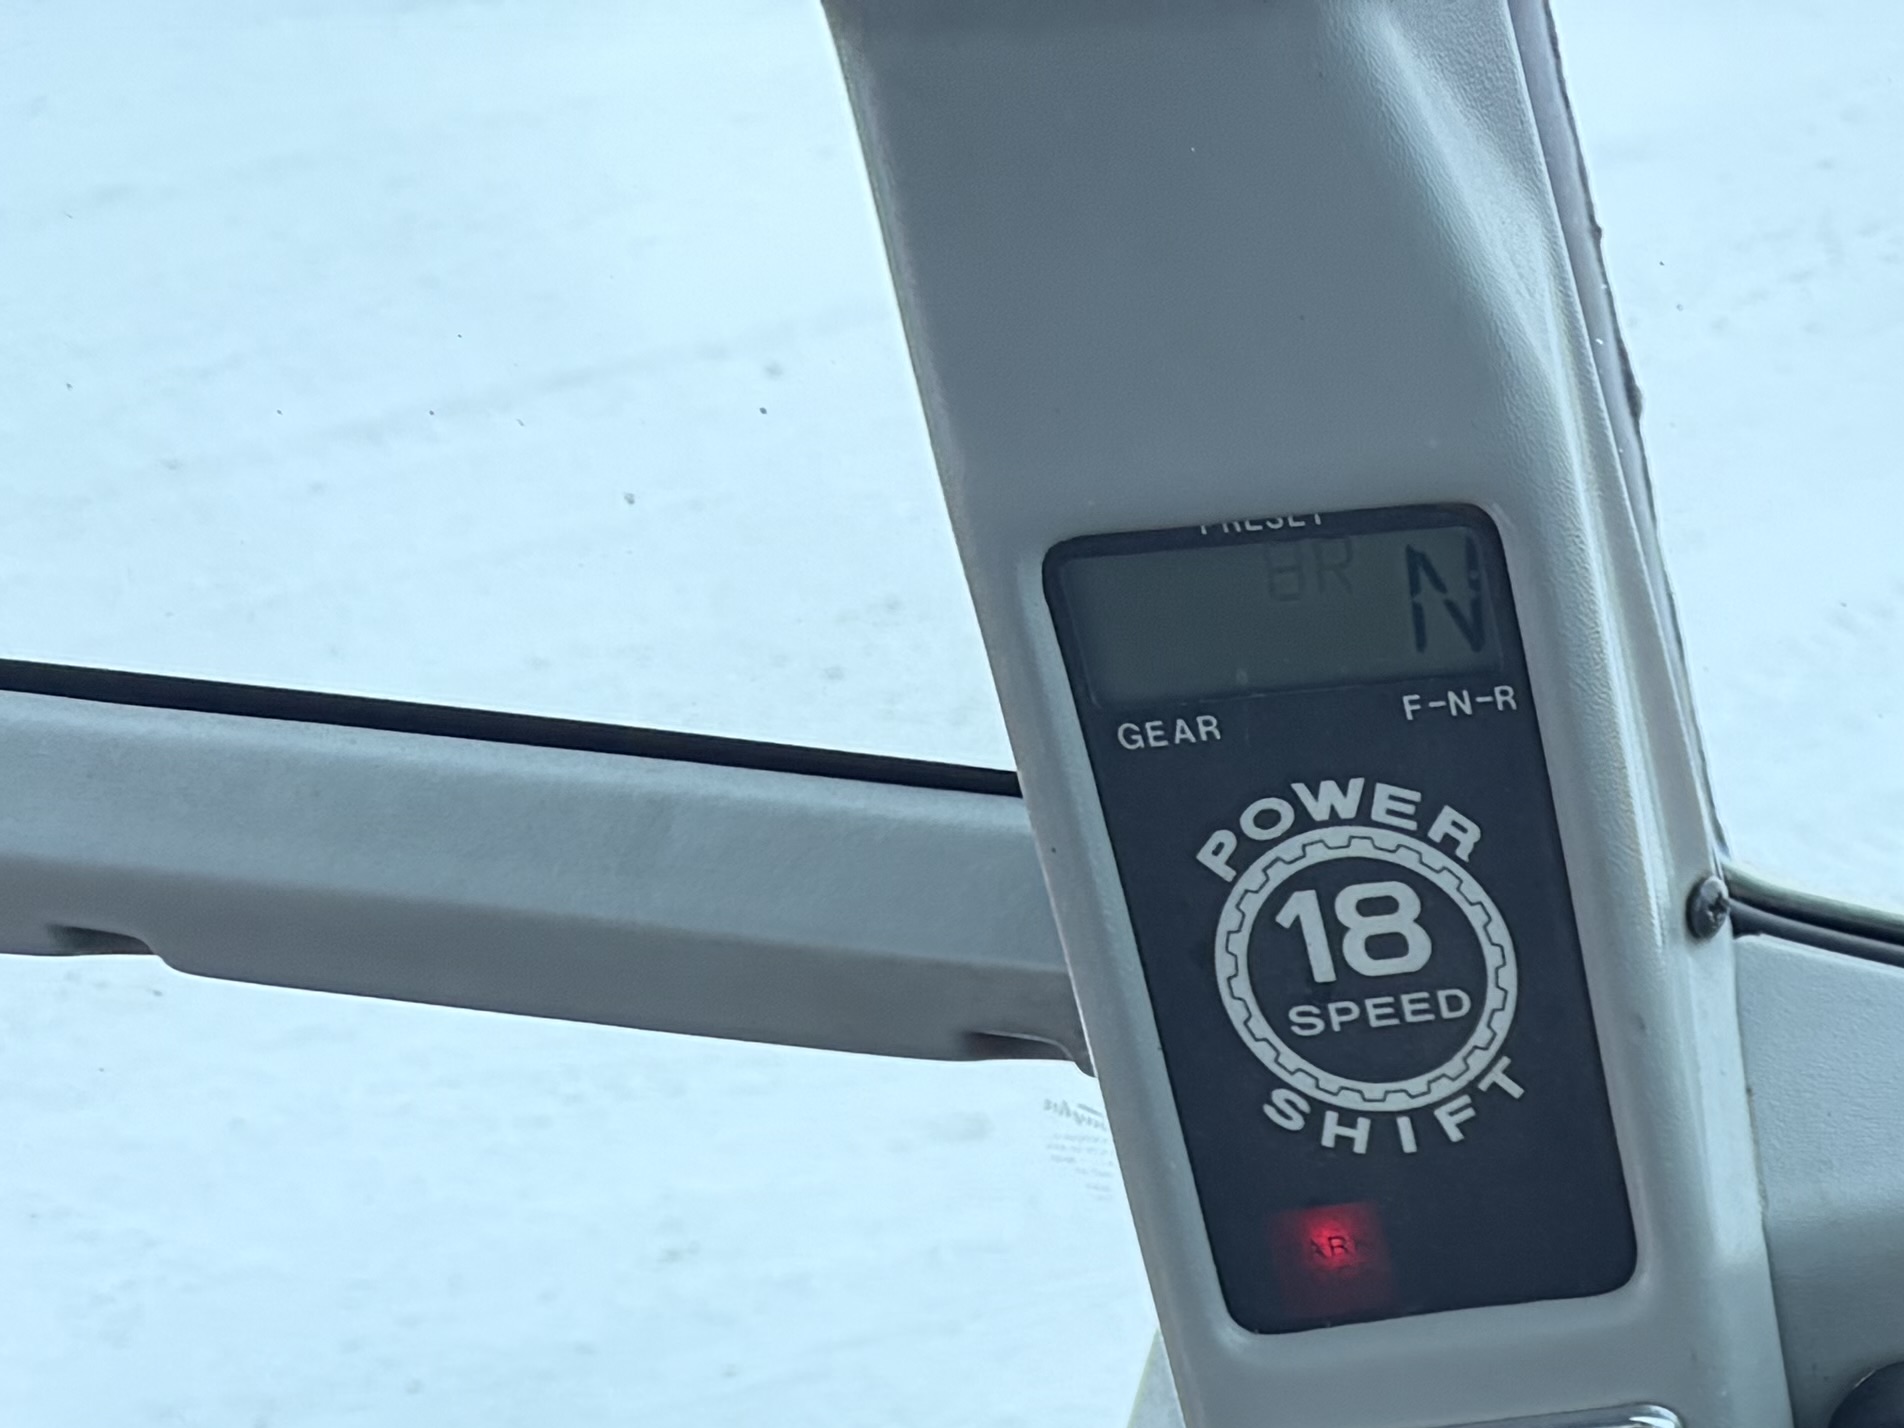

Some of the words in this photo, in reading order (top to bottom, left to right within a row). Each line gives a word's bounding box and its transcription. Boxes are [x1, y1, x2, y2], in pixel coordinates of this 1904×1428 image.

[1405, 536, 1487, 653] N
[1117, 715, 1222, 750] GEAR
[1402, 685, 1518, 721] F-N-R
[1196, 777, 1482, 882] POWER
[1275, 881, 1432, 982] 18
[1288, 988, 1472, 1036] SPEED
[1262, 1056, 1525, 1154] SHIFT
